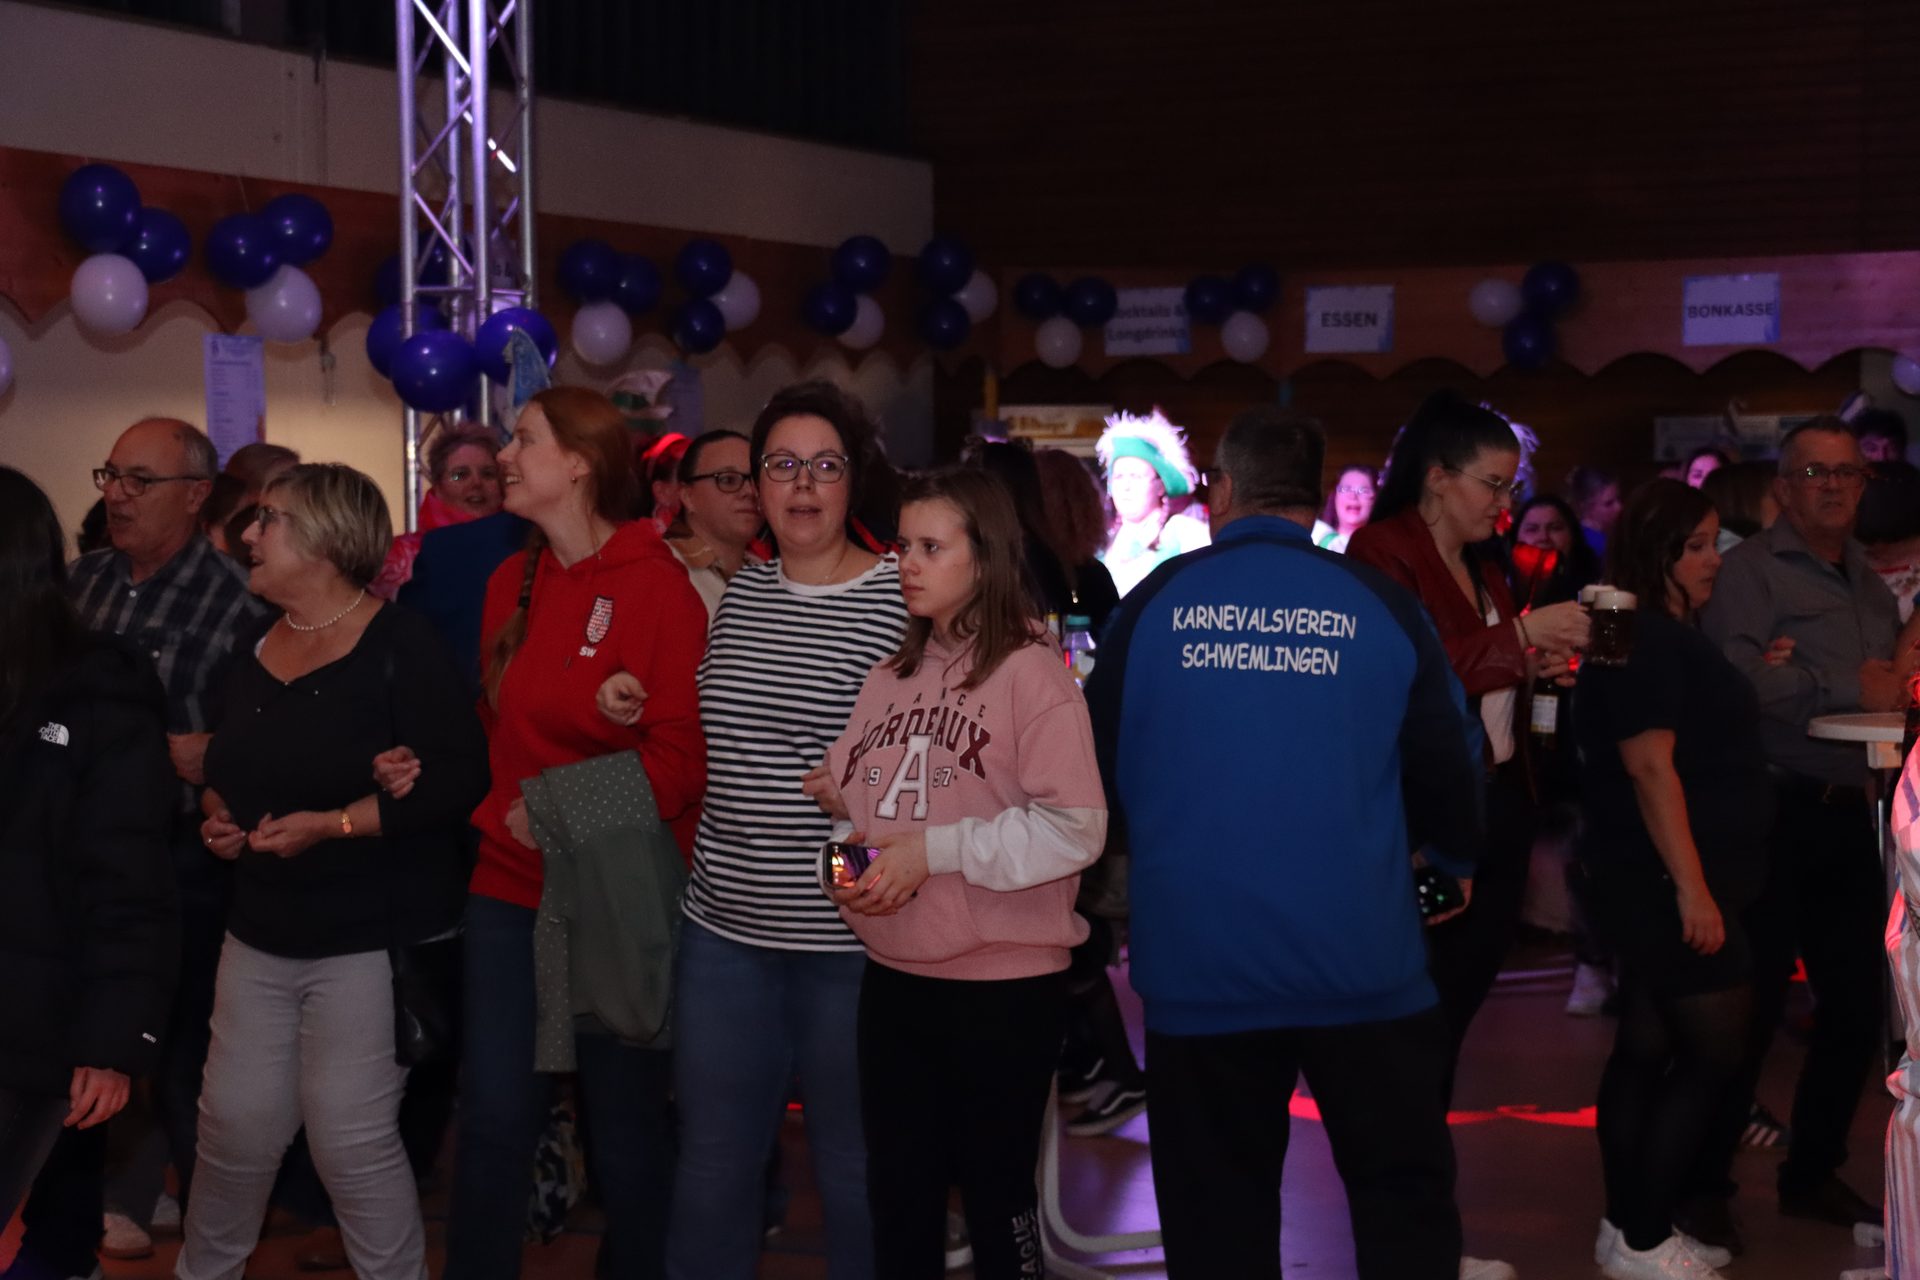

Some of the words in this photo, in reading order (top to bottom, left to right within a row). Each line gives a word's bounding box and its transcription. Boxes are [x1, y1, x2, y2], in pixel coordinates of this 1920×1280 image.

[1113, 304, 1171, 319] ocktails
[1688, 302, 1775, 319] BONKASSE
[1321, 311, 1378, 328] ESSEN
[1172, 605, 1357, 640] KARNEVALSVEREIN
[579, 645, 597, 658] SW
[1181, 643, 1340, 676] SCHWEMLINGEN
[840, 706, 991, 790] BORDEAUX
